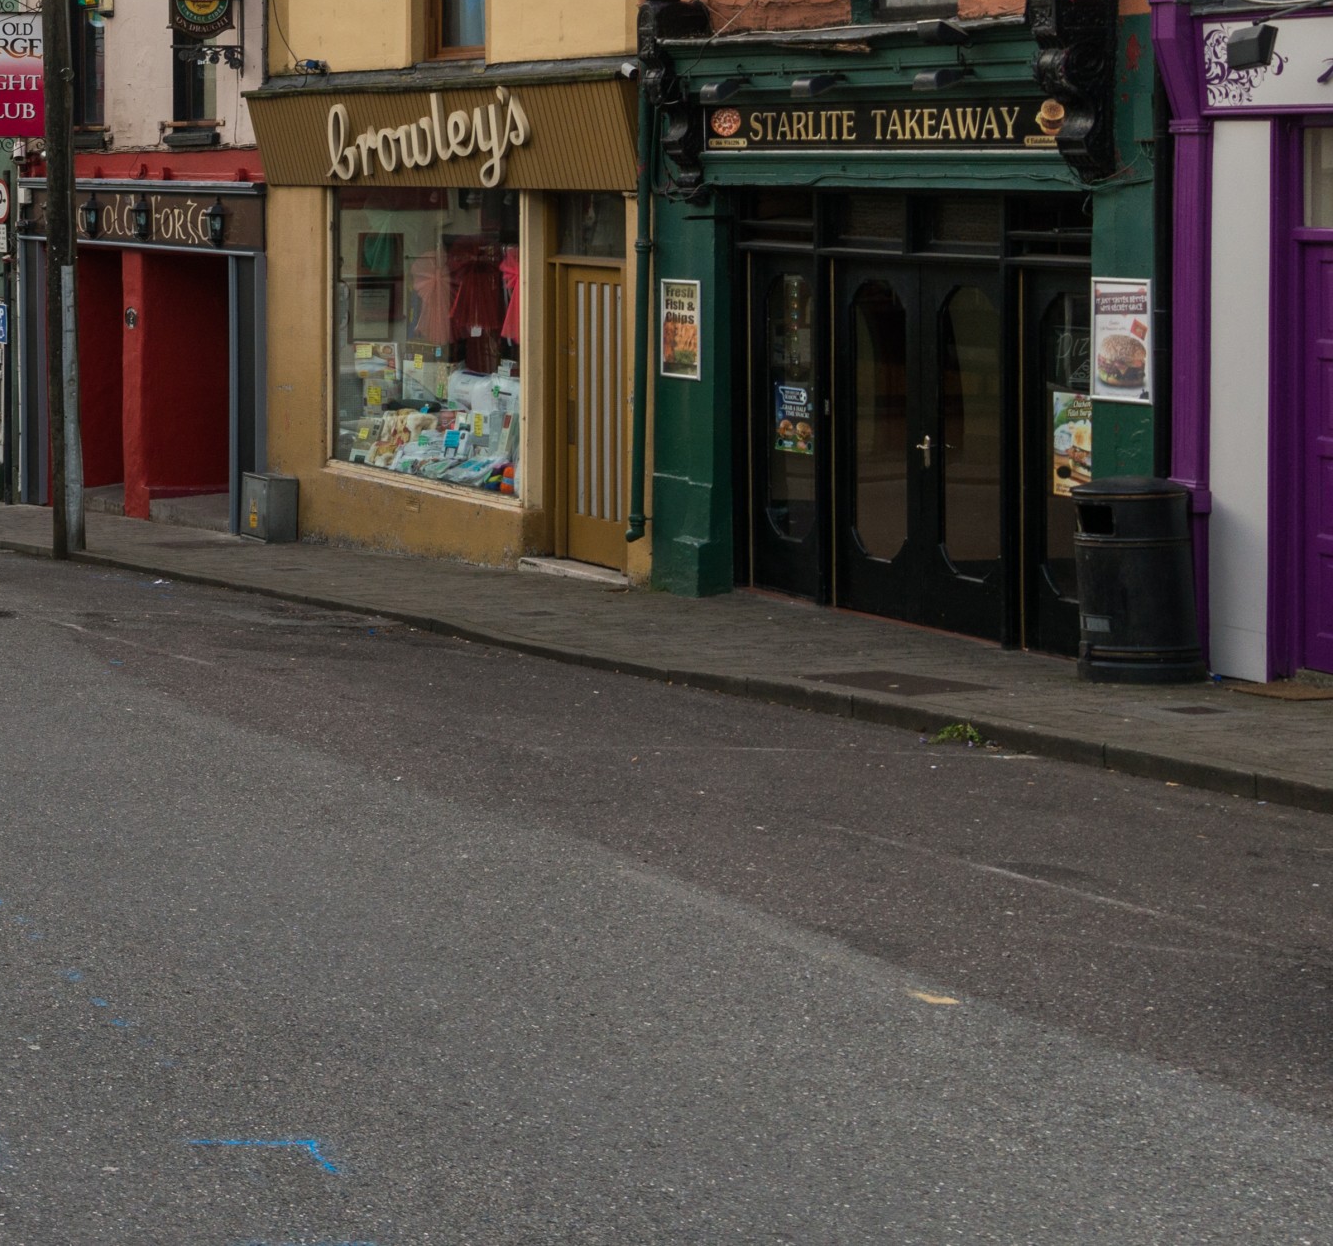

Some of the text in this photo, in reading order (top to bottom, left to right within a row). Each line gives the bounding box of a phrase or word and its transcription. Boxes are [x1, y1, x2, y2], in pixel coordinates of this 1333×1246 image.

[2, 22, 33, 36] OLD
[749, 107, 1020, 141] STARLITE TAKEAWAY
[665, 285, 694, 298] Fresh
[665, 298, 695, 311] Fish &
[0, 308, 4, 319] P
[666, 312, 694, 325] Chips
